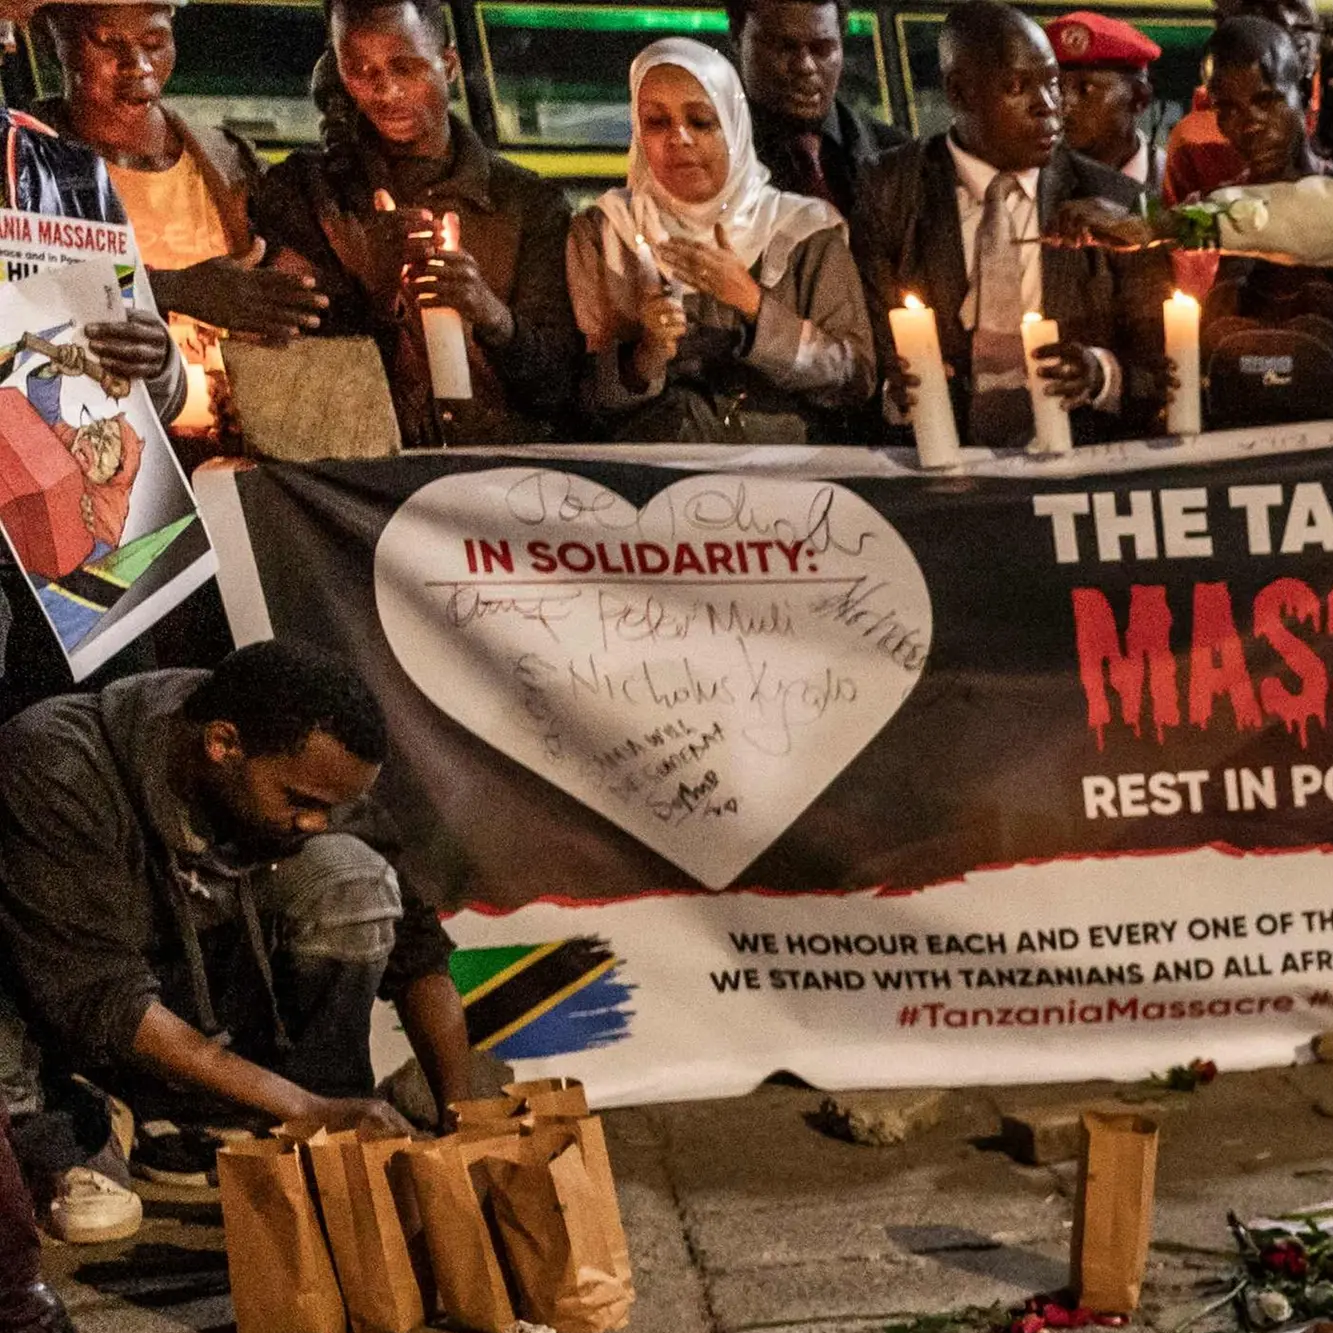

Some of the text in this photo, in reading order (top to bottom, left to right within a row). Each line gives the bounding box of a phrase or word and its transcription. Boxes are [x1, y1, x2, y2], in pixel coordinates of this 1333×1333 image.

[38, 219, 128, 256] MASSACRE
[1033, 487, 1213, 563] THE
[463, 539, 820, 576] IN SOLIDARITY:
[1082, 769, 1210, 819] REST
[1225, 766, 1274, 812] IN
[730, 932, 778, 956] WE
[786, 932, 918, 957] HONOUR
[927, 932, 1005, 957] EACH
[1016, 926, 1079, 953] AND
[1089, 920, 1178, 949] EVERY
[1187, 915, 1248, 942] ONE
[1257, 912, 1294, 936] OF
[710, 970, 761, 995] WE
[768, 968, 865, 993] STAND
[874, 968, 951, 991] WITH
[958, 965, 1145, 990] TANZANIANS
[1153, 959, 1214, 984] AND
[1224, 955, 1273, 978] ALL
[897, 991, 1294, 1030] #TanzaniaMassacre
